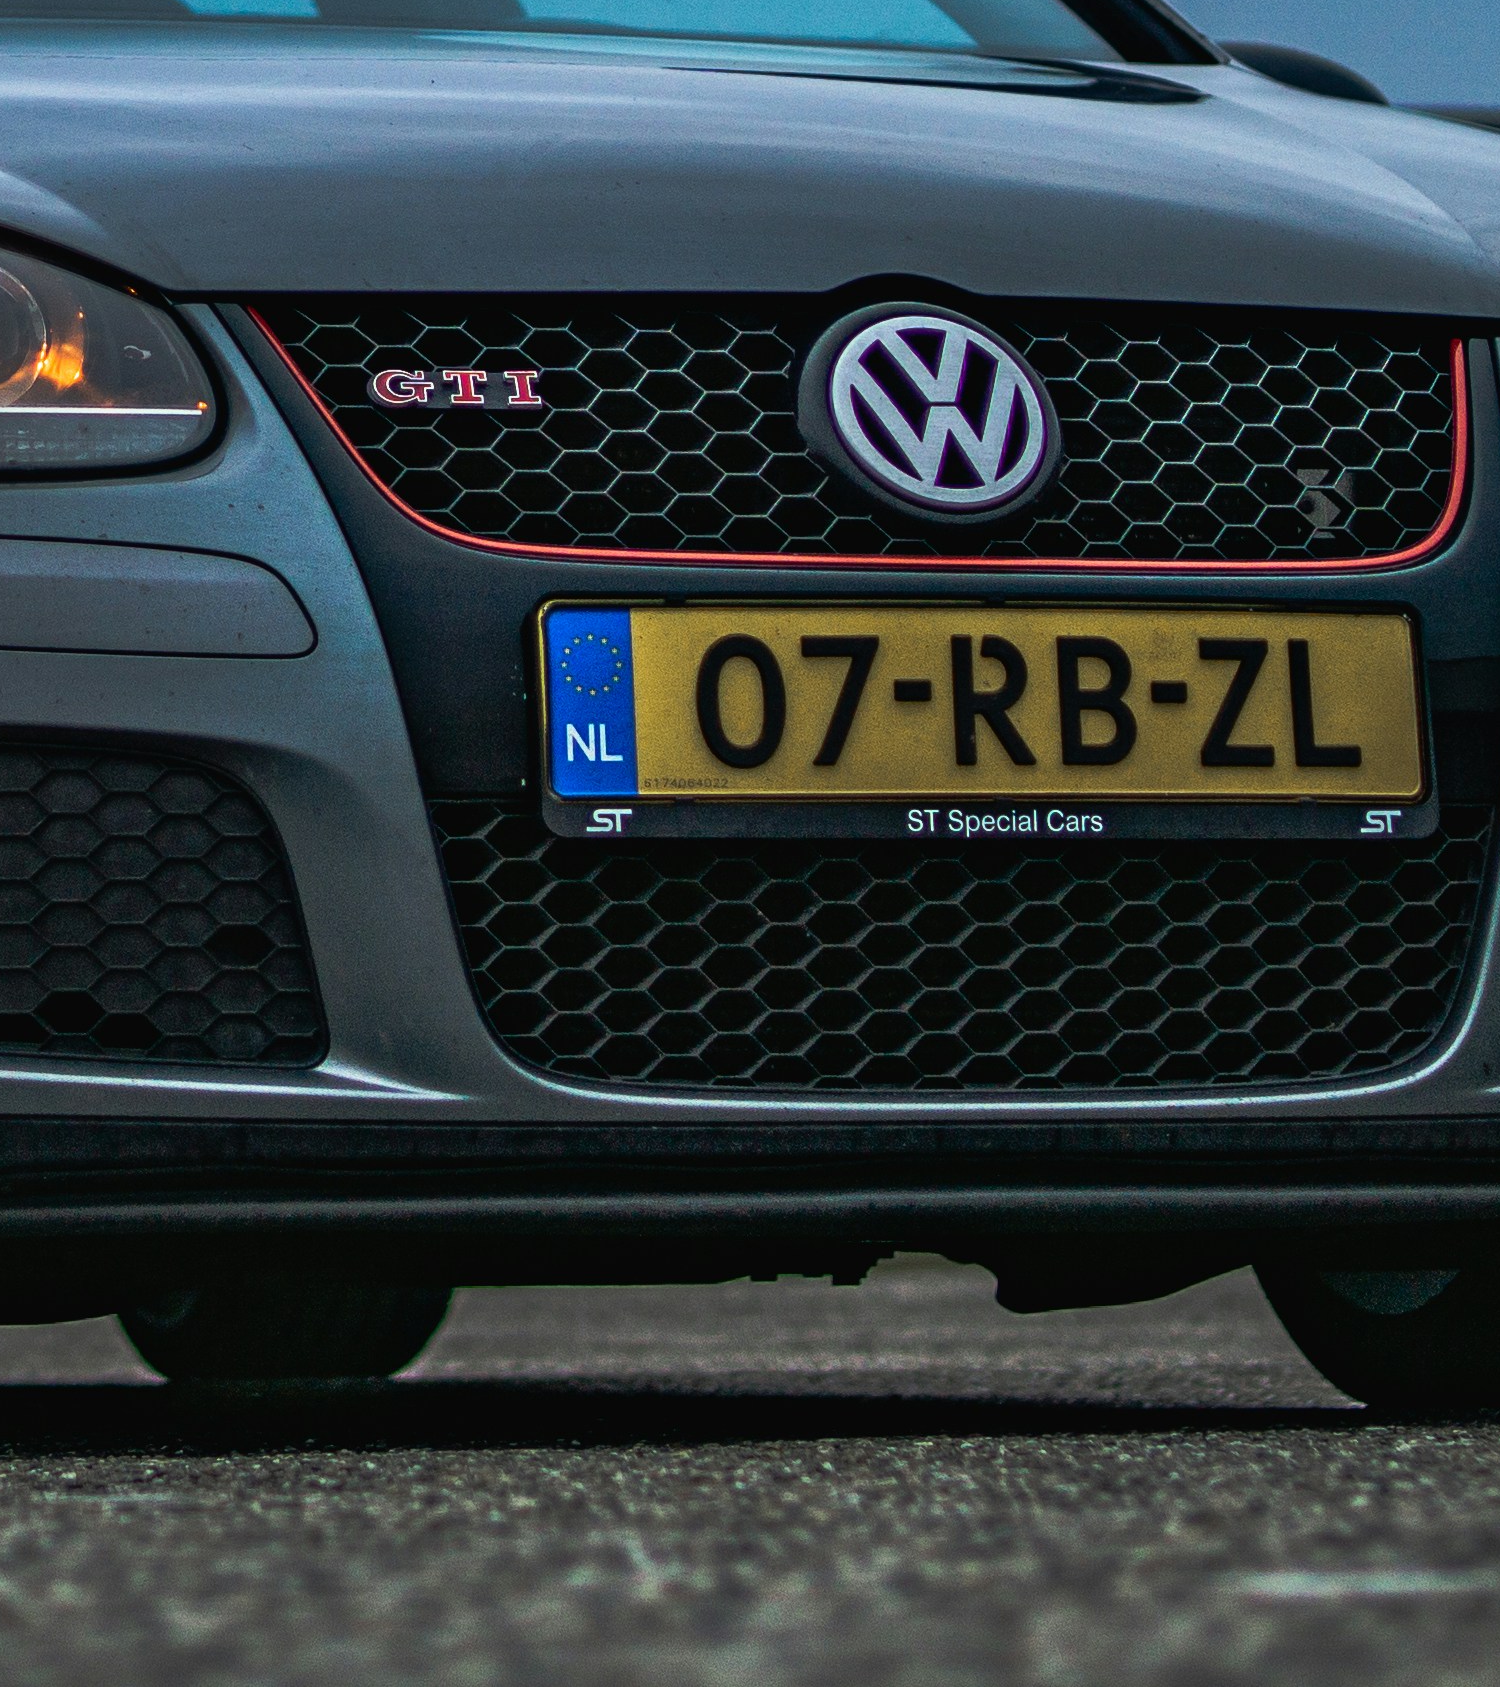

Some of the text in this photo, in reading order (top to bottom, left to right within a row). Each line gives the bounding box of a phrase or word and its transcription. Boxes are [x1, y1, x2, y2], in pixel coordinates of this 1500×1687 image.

[373, 369, 542, 405] GTI
[696, 633, 1362, 769] 07-RB-ZL
[566, 723, 623, 762] NL
[586, 808, 633, 832] ST
[907, 809, 1104, 838] ST Special Cars
[1360, 810, 1402, 834] ST
